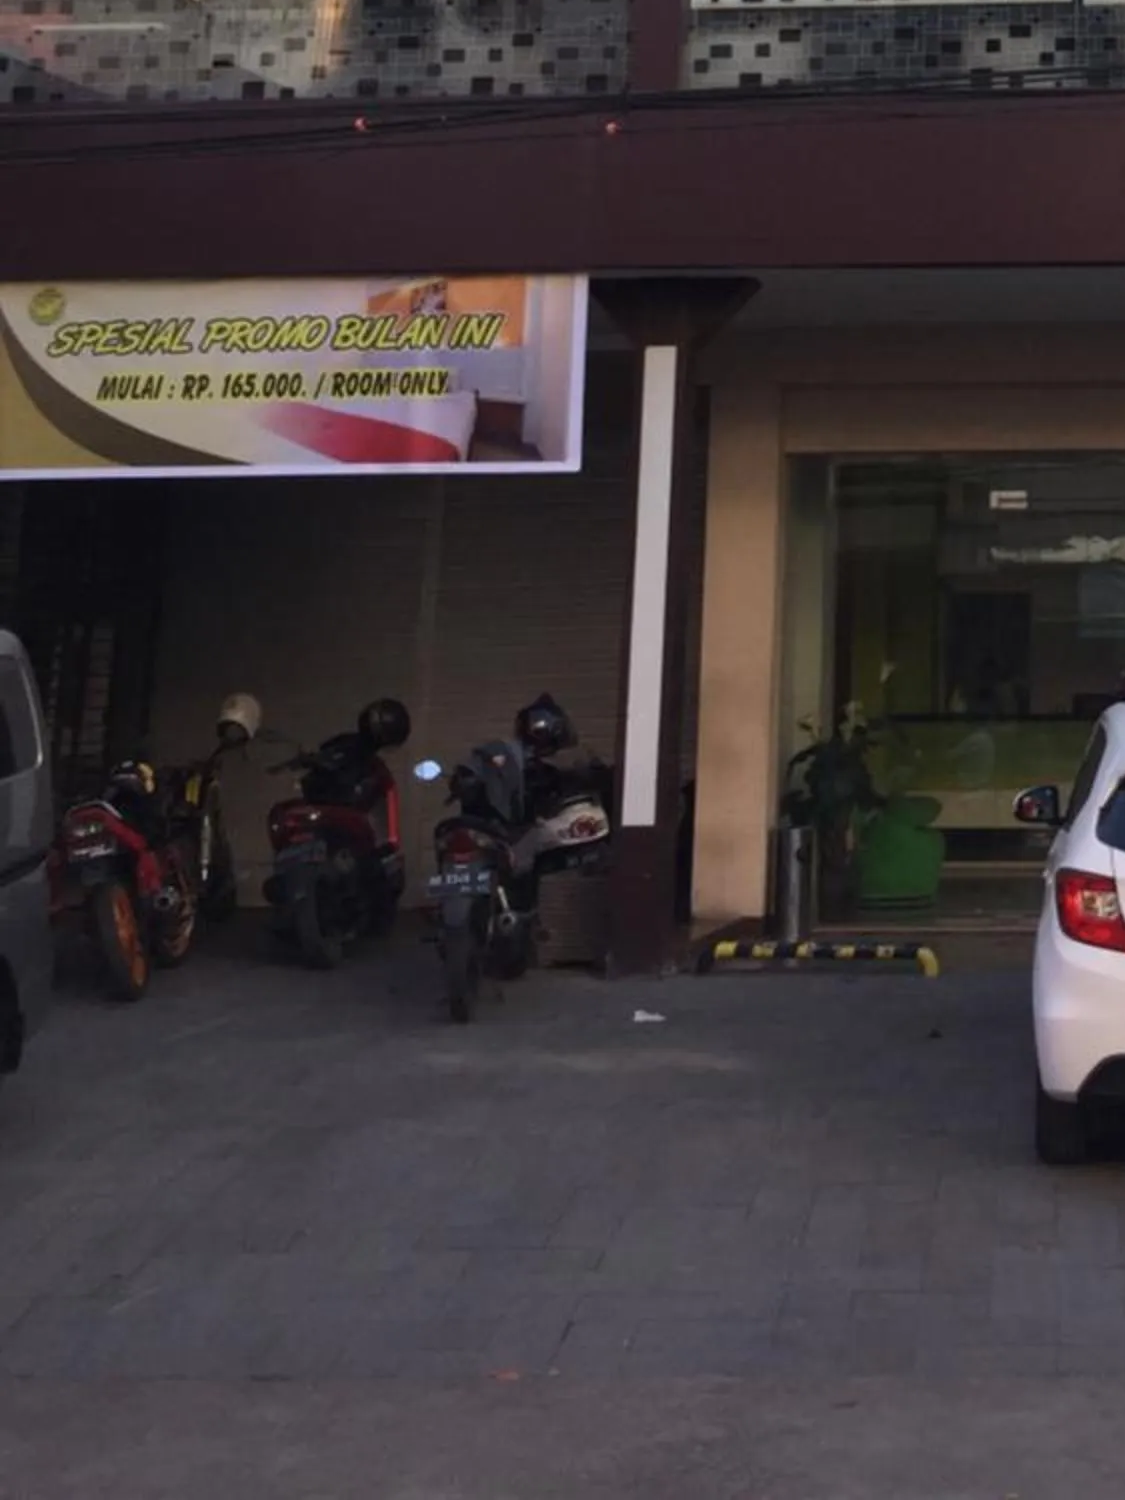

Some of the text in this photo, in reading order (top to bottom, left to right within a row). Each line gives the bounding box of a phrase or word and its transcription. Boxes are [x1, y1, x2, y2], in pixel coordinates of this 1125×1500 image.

[47, 312, 507, 359] SPESIAL PROMO BULAN INI
[97, 373, 164, 401] MULAI
[181, 373, 213, 400] RP.
[331, 371, 392, 398] ROOM
